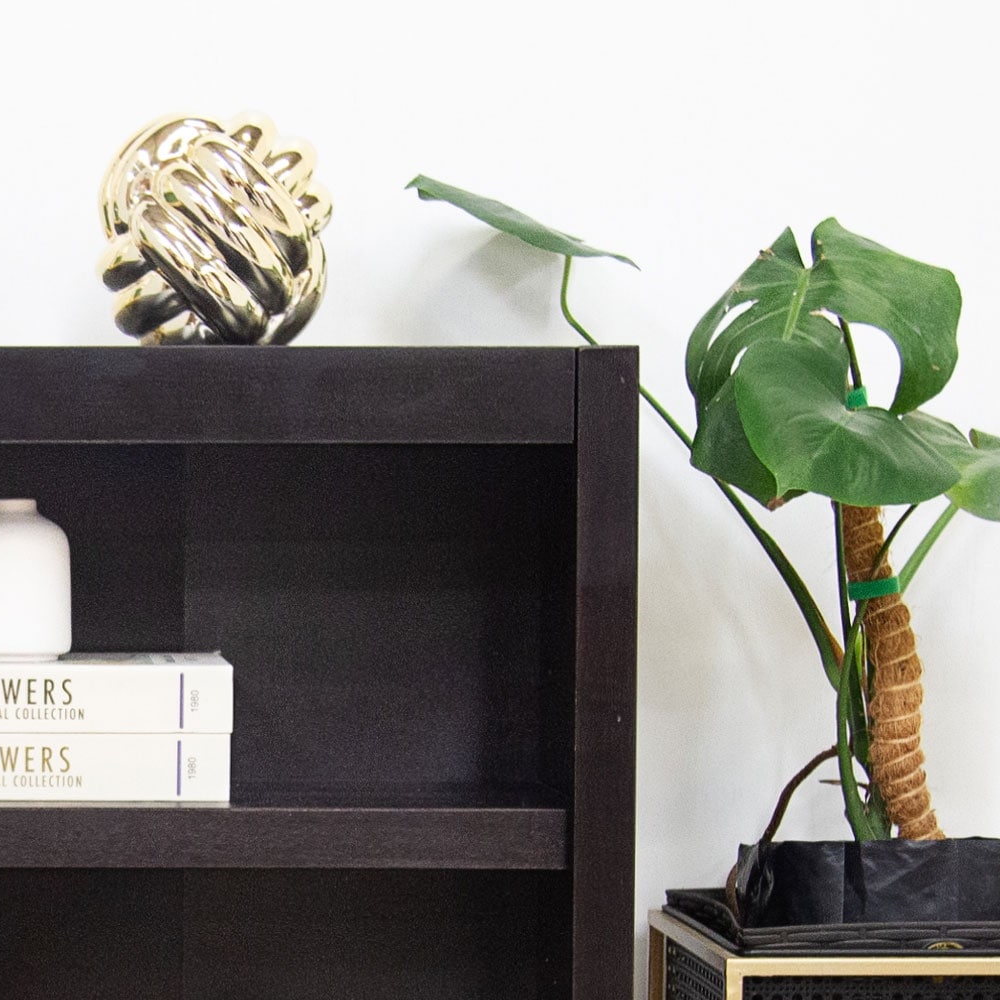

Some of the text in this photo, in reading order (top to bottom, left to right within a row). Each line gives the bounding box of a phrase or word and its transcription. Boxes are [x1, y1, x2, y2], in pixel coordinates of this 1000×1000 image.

[190, 689, 200, 712] 1980
[15, 707, 85, 720] COLLECTION
[187, 757, 197, 779] 1980
[12, 775, 83, 788] COLLECTION
